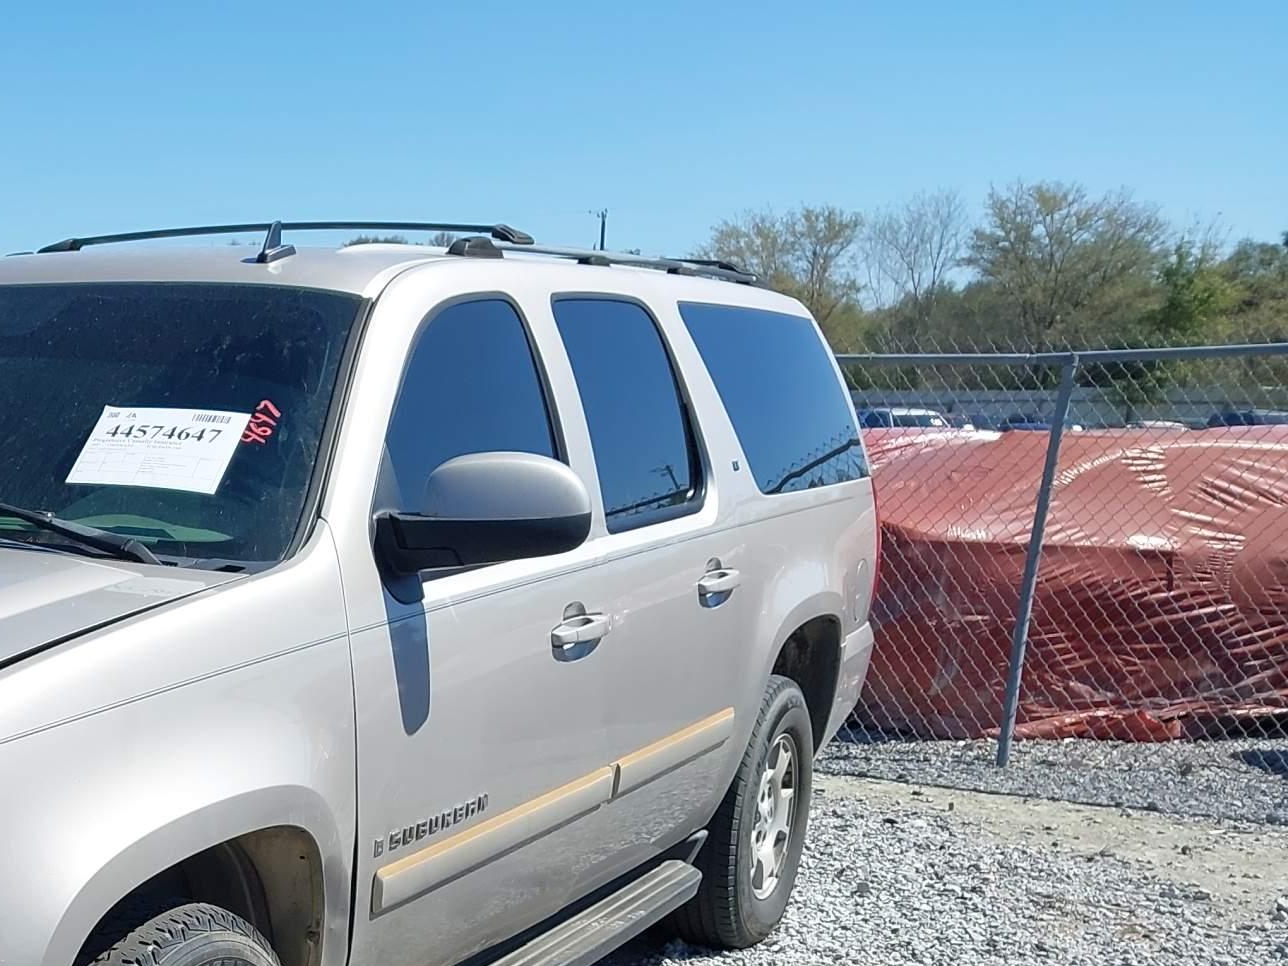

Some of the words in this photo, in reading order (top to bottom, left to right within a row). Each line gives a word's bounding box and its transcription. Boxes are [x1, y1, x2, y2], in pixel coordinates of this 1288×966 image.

[105, 423, 223, 444] 44574647
[241, 399, 282, 444] 4647
[388, 792, 489, 852] SUBURBAN
